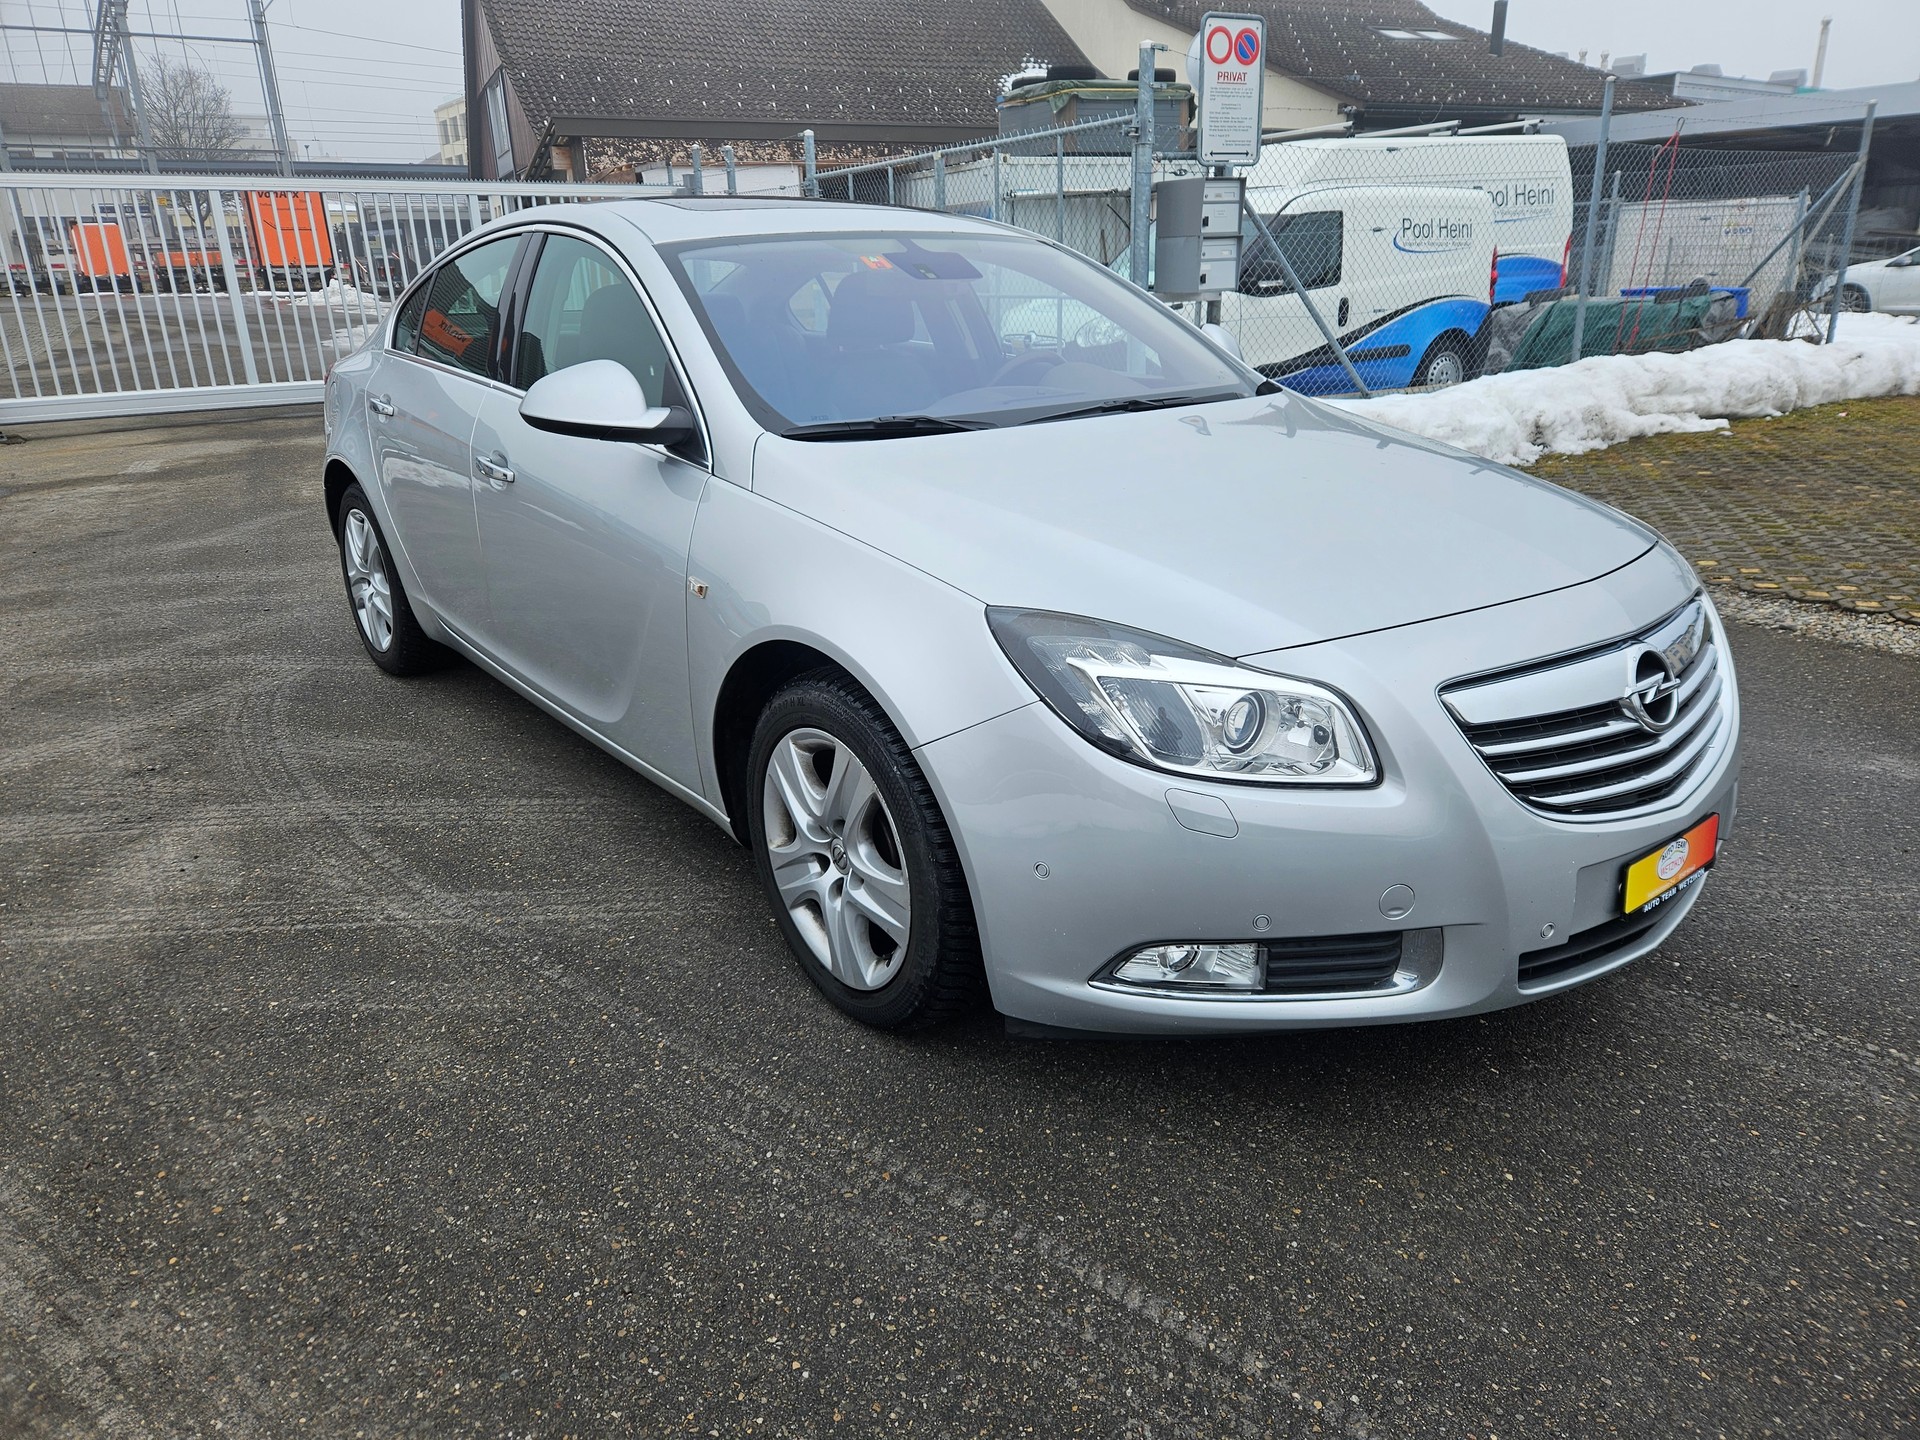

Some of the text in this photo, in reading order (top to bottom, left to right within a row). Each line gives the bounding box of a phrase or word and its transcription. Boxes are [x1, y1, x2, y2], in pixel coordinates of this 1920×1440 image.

[1217, 71, 1248, 82] PRIVAT
[1487, 183, 1554, 206] ool Heini
[1402, 218, 1472, 238] Pool Heini
[1643, 898, 1660, 913] AUTO
[1661, 887, 1677, 901] TEAM
